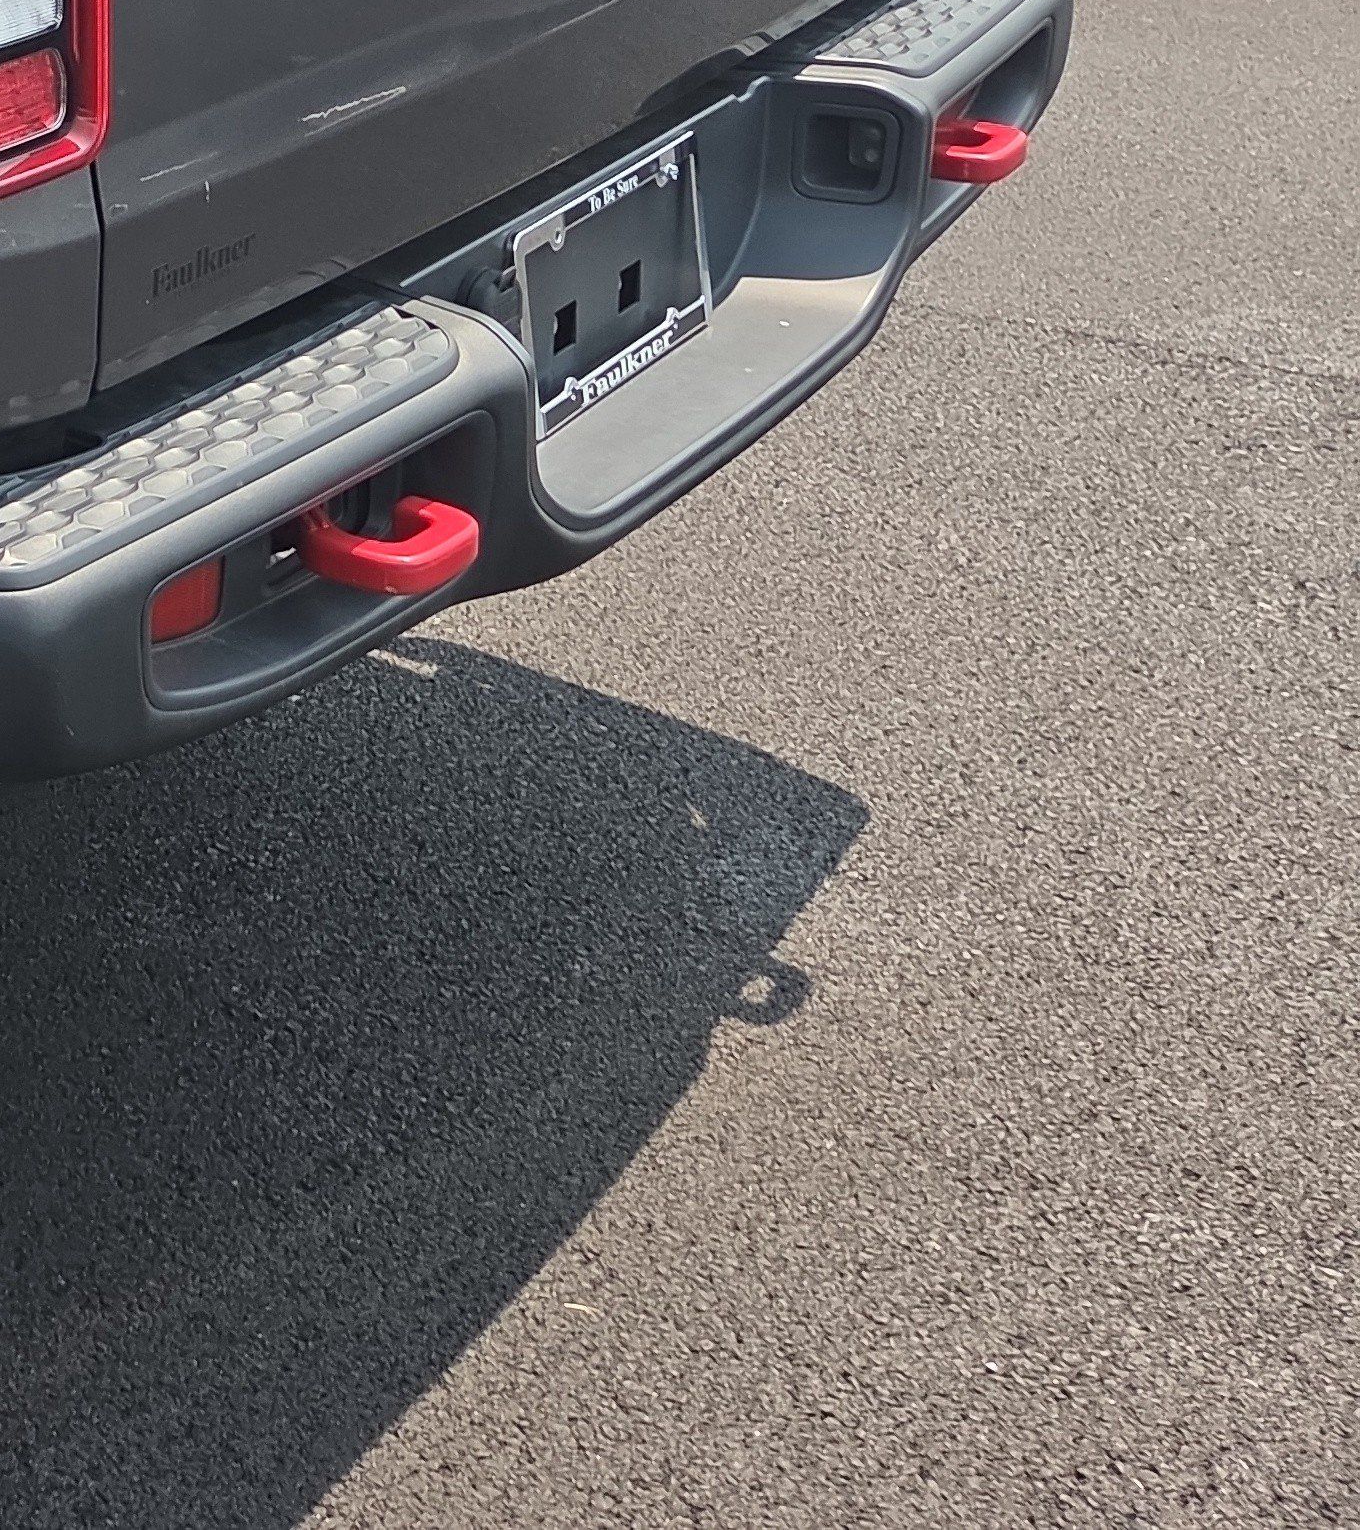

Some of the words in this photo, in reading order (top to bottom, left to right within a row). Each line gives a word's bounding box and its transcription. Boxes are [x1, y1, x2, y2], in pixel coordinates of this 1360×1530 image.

[587, 194, 602, 213] To
[603, 187, 616, 206] Be
[616, 174, 639, 198] Sure
[151, 233, 256, 299] Faulkner
[580, 330, 674, 407] Faulkner
